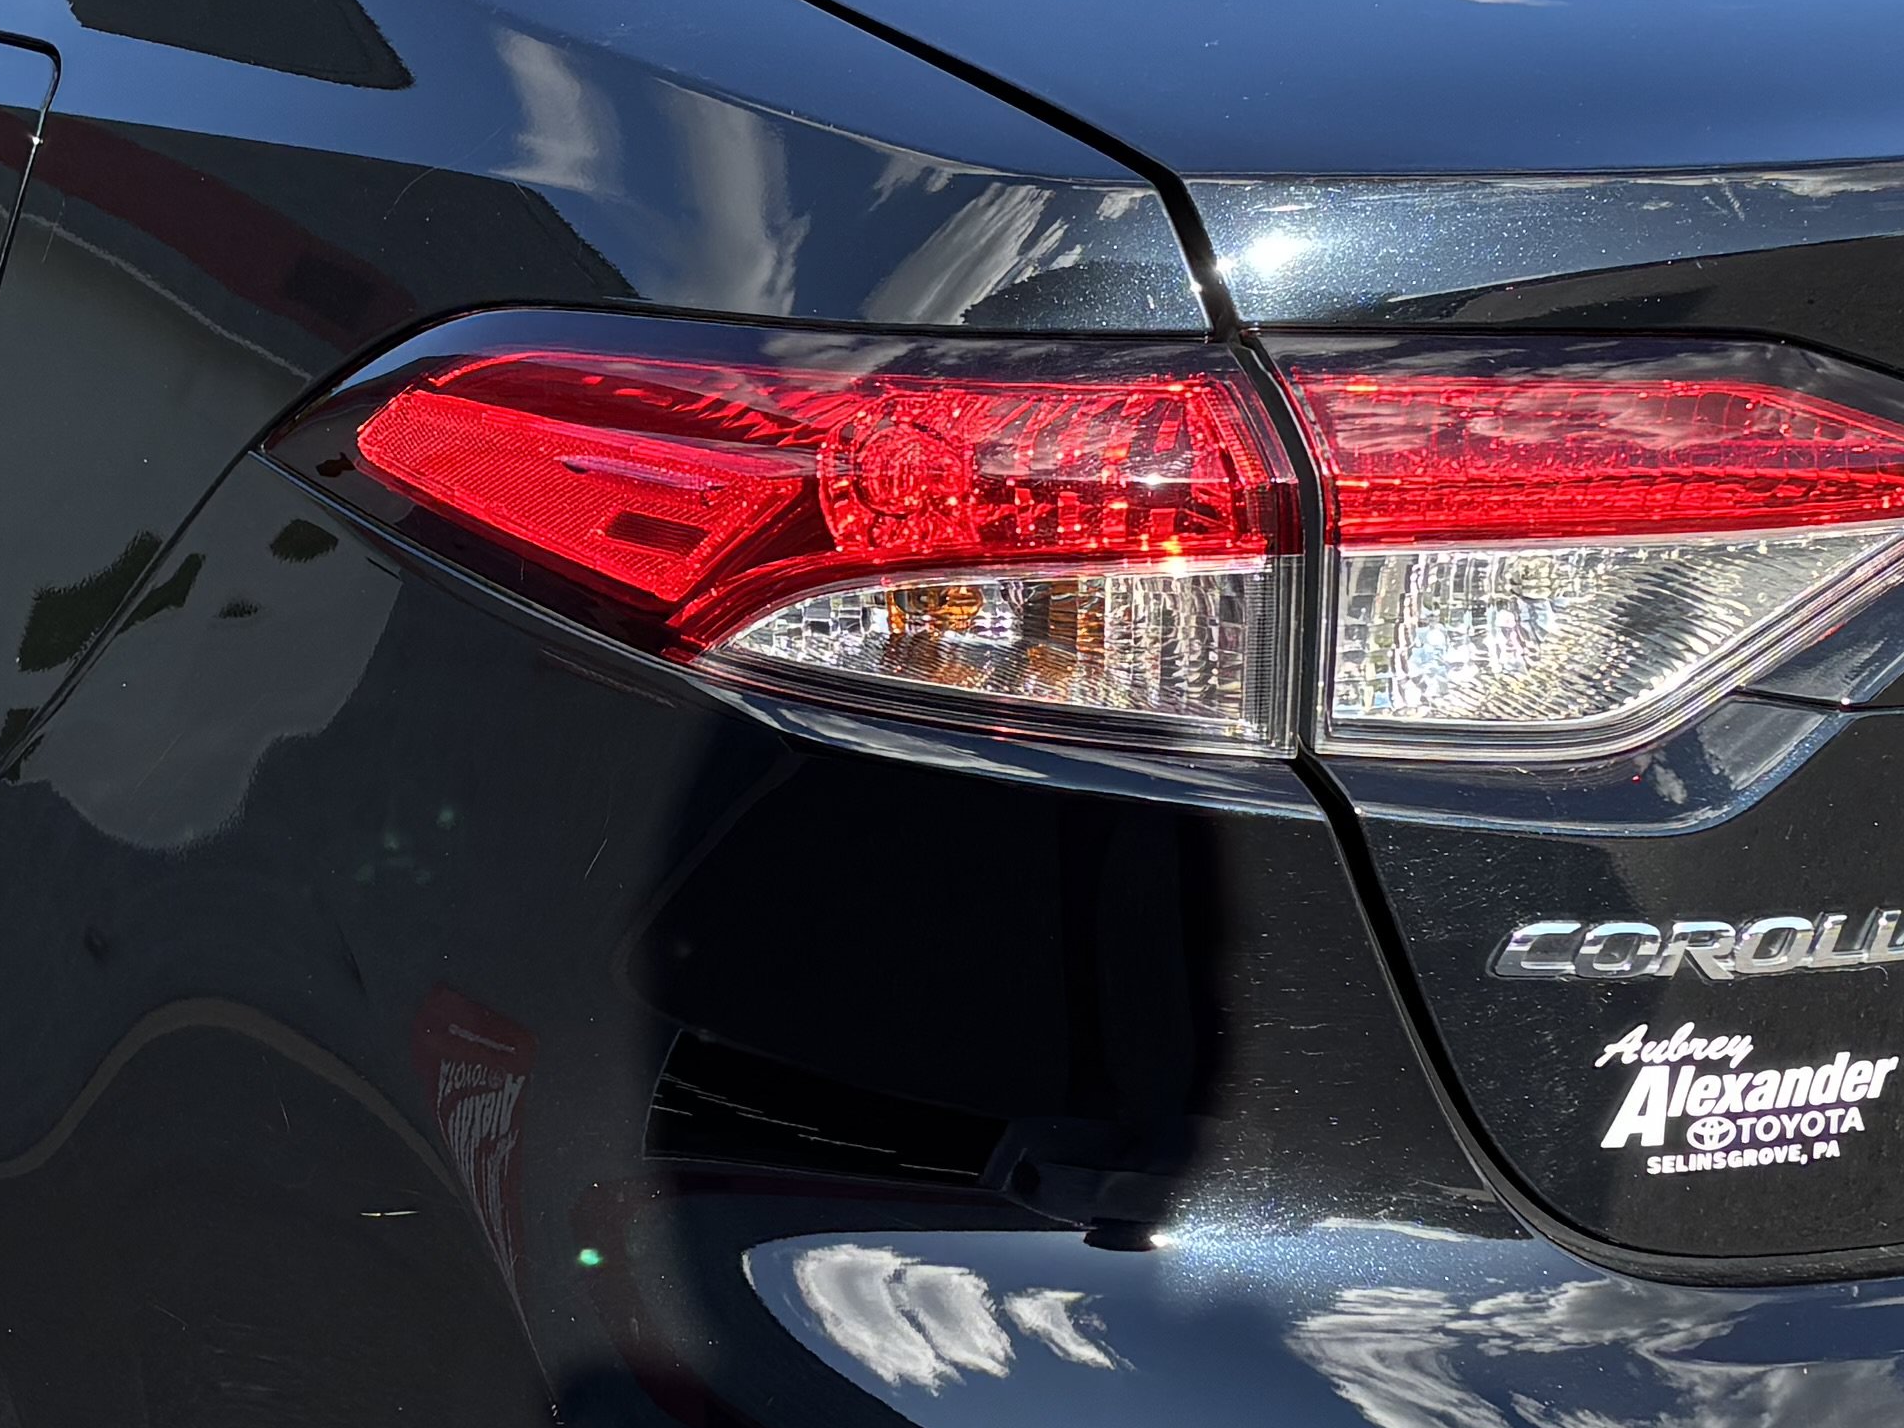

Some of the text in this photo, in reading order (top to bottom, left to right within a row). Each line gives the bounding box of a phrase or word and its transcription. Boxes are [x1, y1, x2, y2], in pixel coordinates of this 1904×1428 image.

[1594, 1021, 1754, 1069] Aubrey
[1600, 1051, 1900, 1149] Alexander
[1736, 1107, 1866, 1144] TOYOTA
[1647, 1140, 1841, 1175] SELINSGROVE, PA
